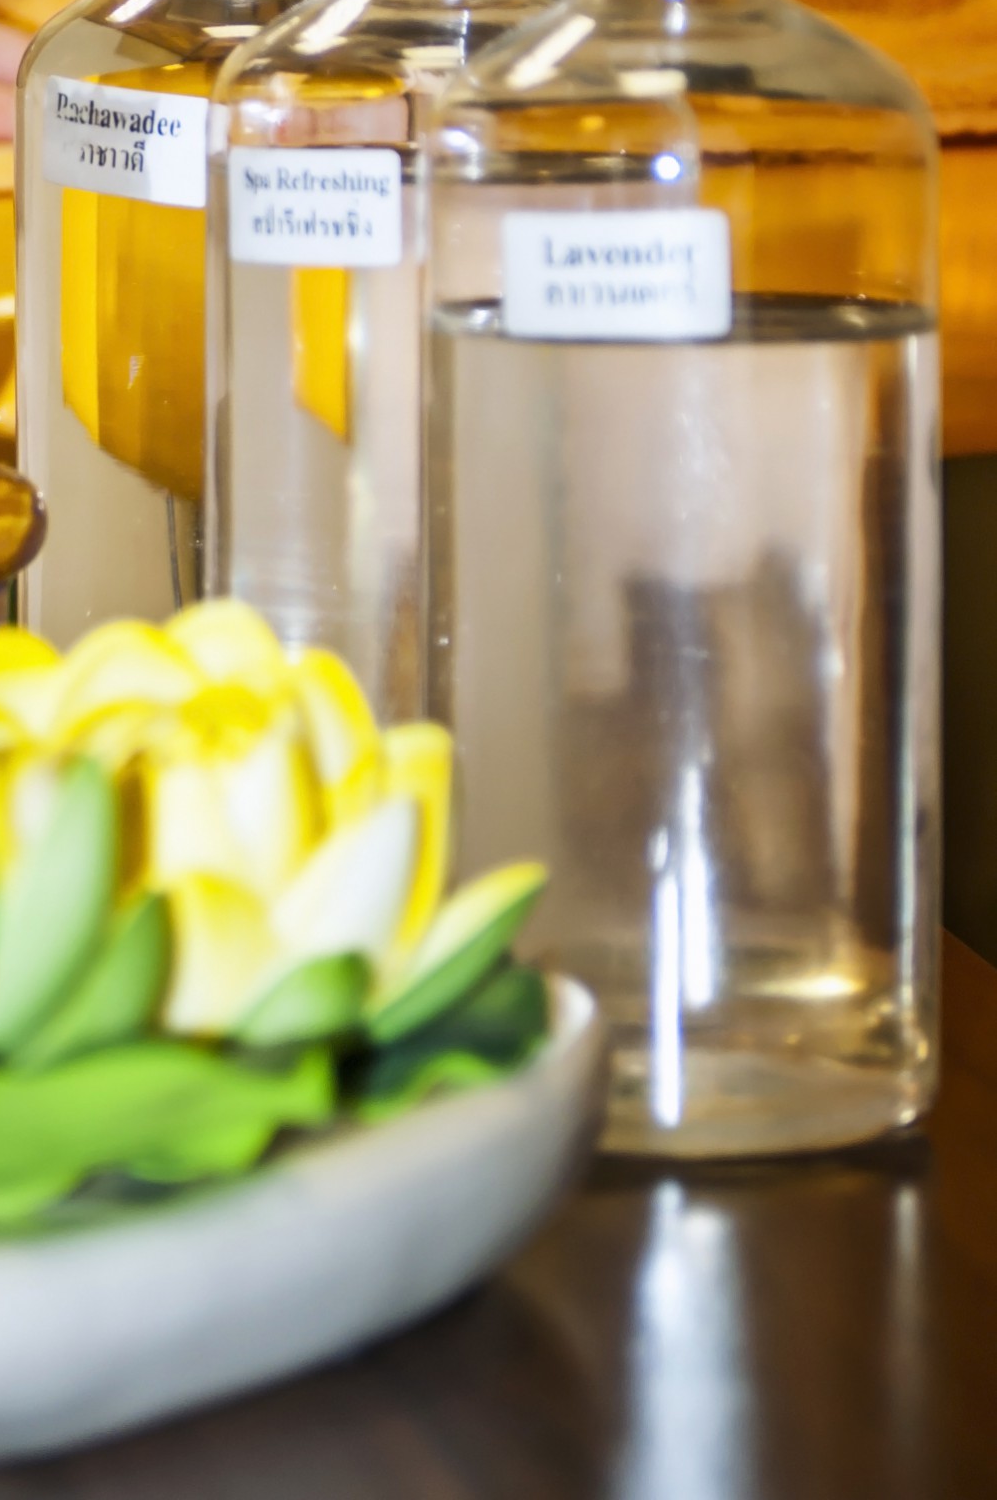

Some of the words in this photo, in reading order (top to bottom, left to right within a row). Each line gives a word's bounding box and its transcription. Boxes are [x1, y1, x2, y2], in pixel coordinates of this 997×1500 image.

[56, 92, 182, 137] Rachawadee
[243, 166, 271, 194] Spa
[276, 167, 390, 197] Refreshing
[543, 235, 695, 265] Lavender
